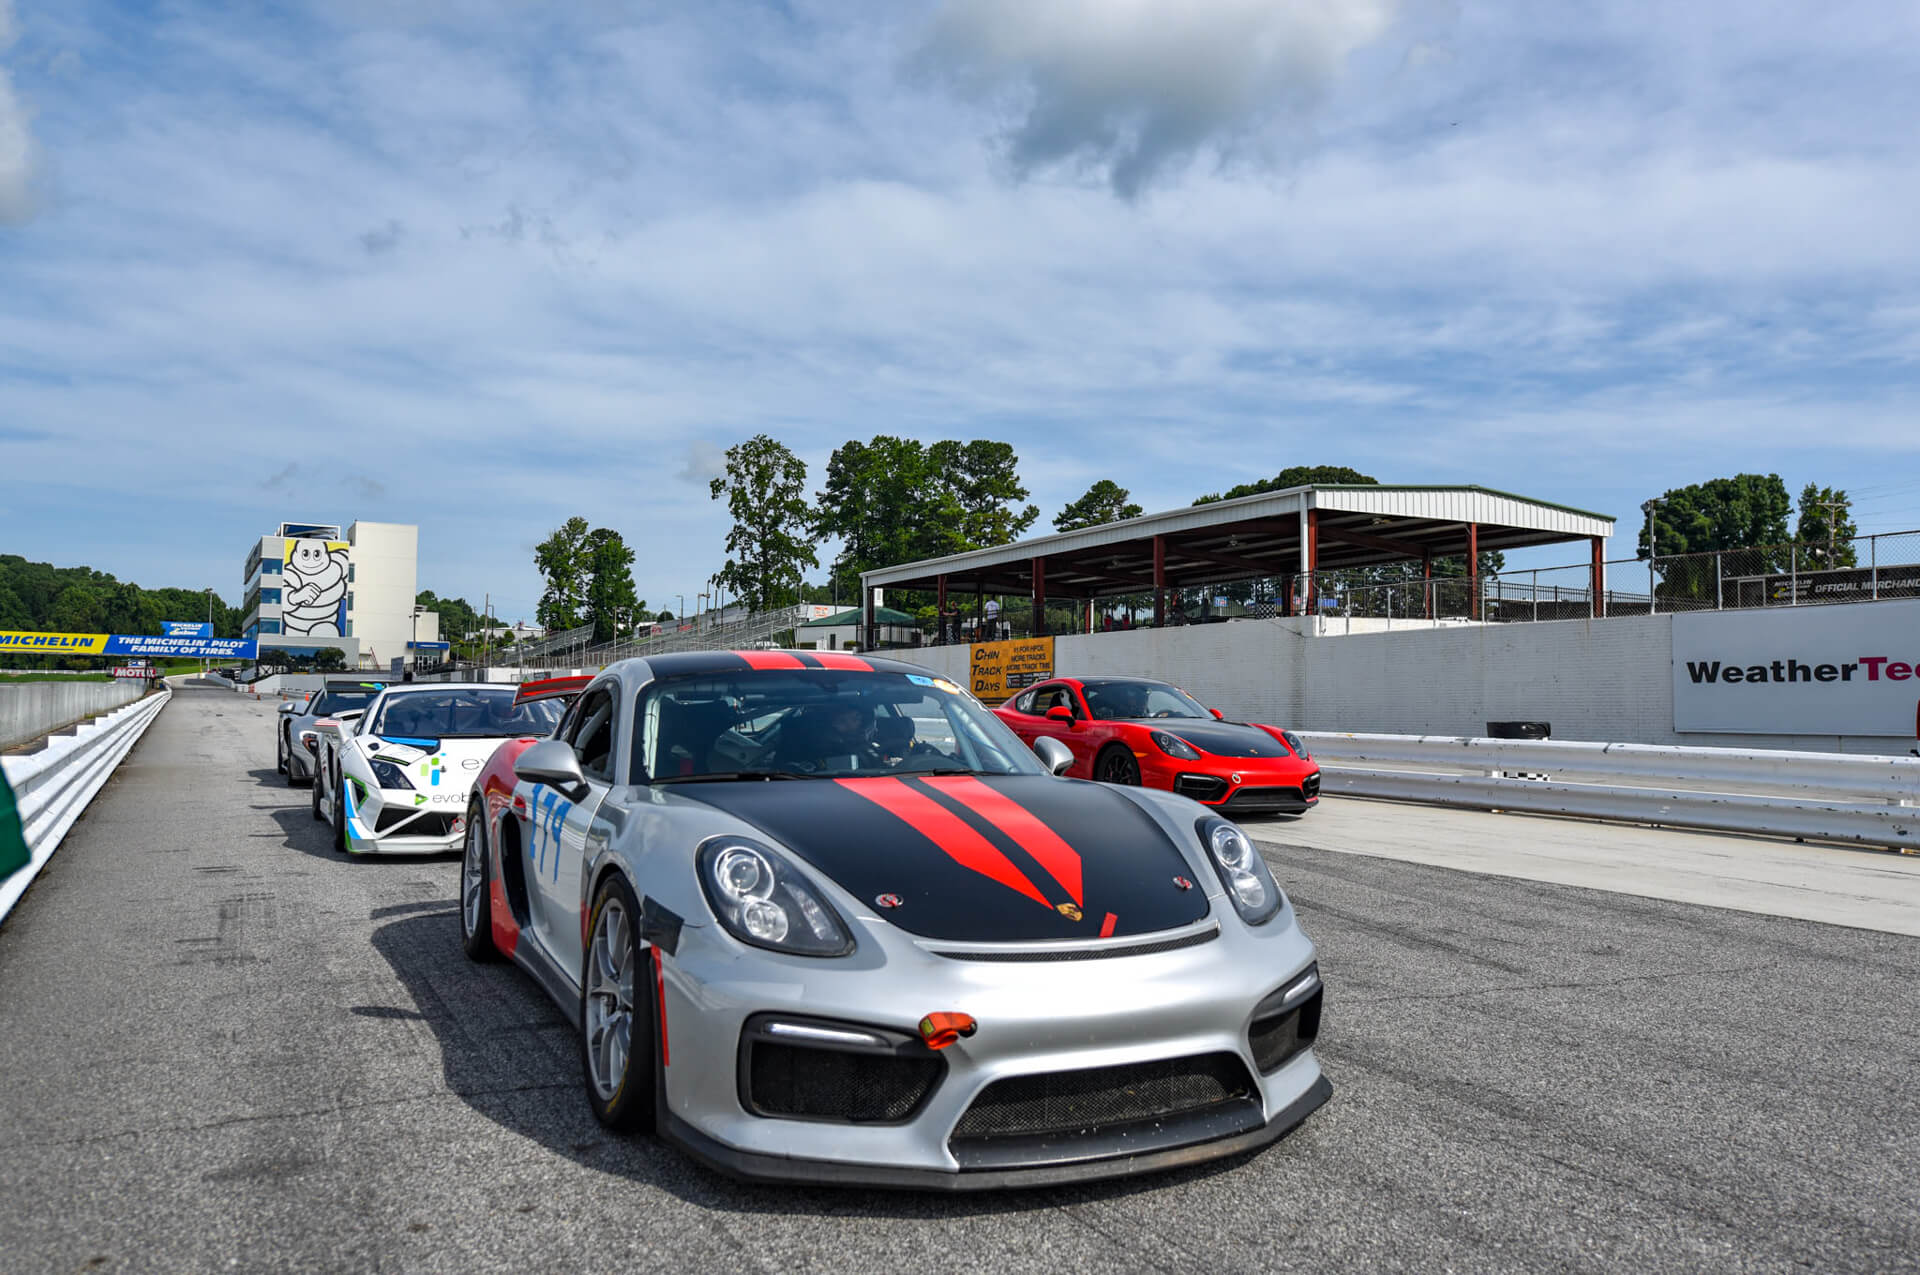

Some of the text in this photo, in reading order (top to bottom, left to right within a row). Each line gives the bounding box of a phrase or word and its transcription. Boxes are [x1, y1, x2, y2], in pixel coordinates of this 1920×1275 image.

[1815, 582, 1859, 593] OFFICIAL
[0, 635, 95, 647] MICHELIN
[118, 637, 245, 648] THE MICHELIN PILOT
[131, 645, 182, 654] FAMILY
[199, 647, 235, 655] TIRES.
[1686, 656, 1920, 684] WeatherTe
